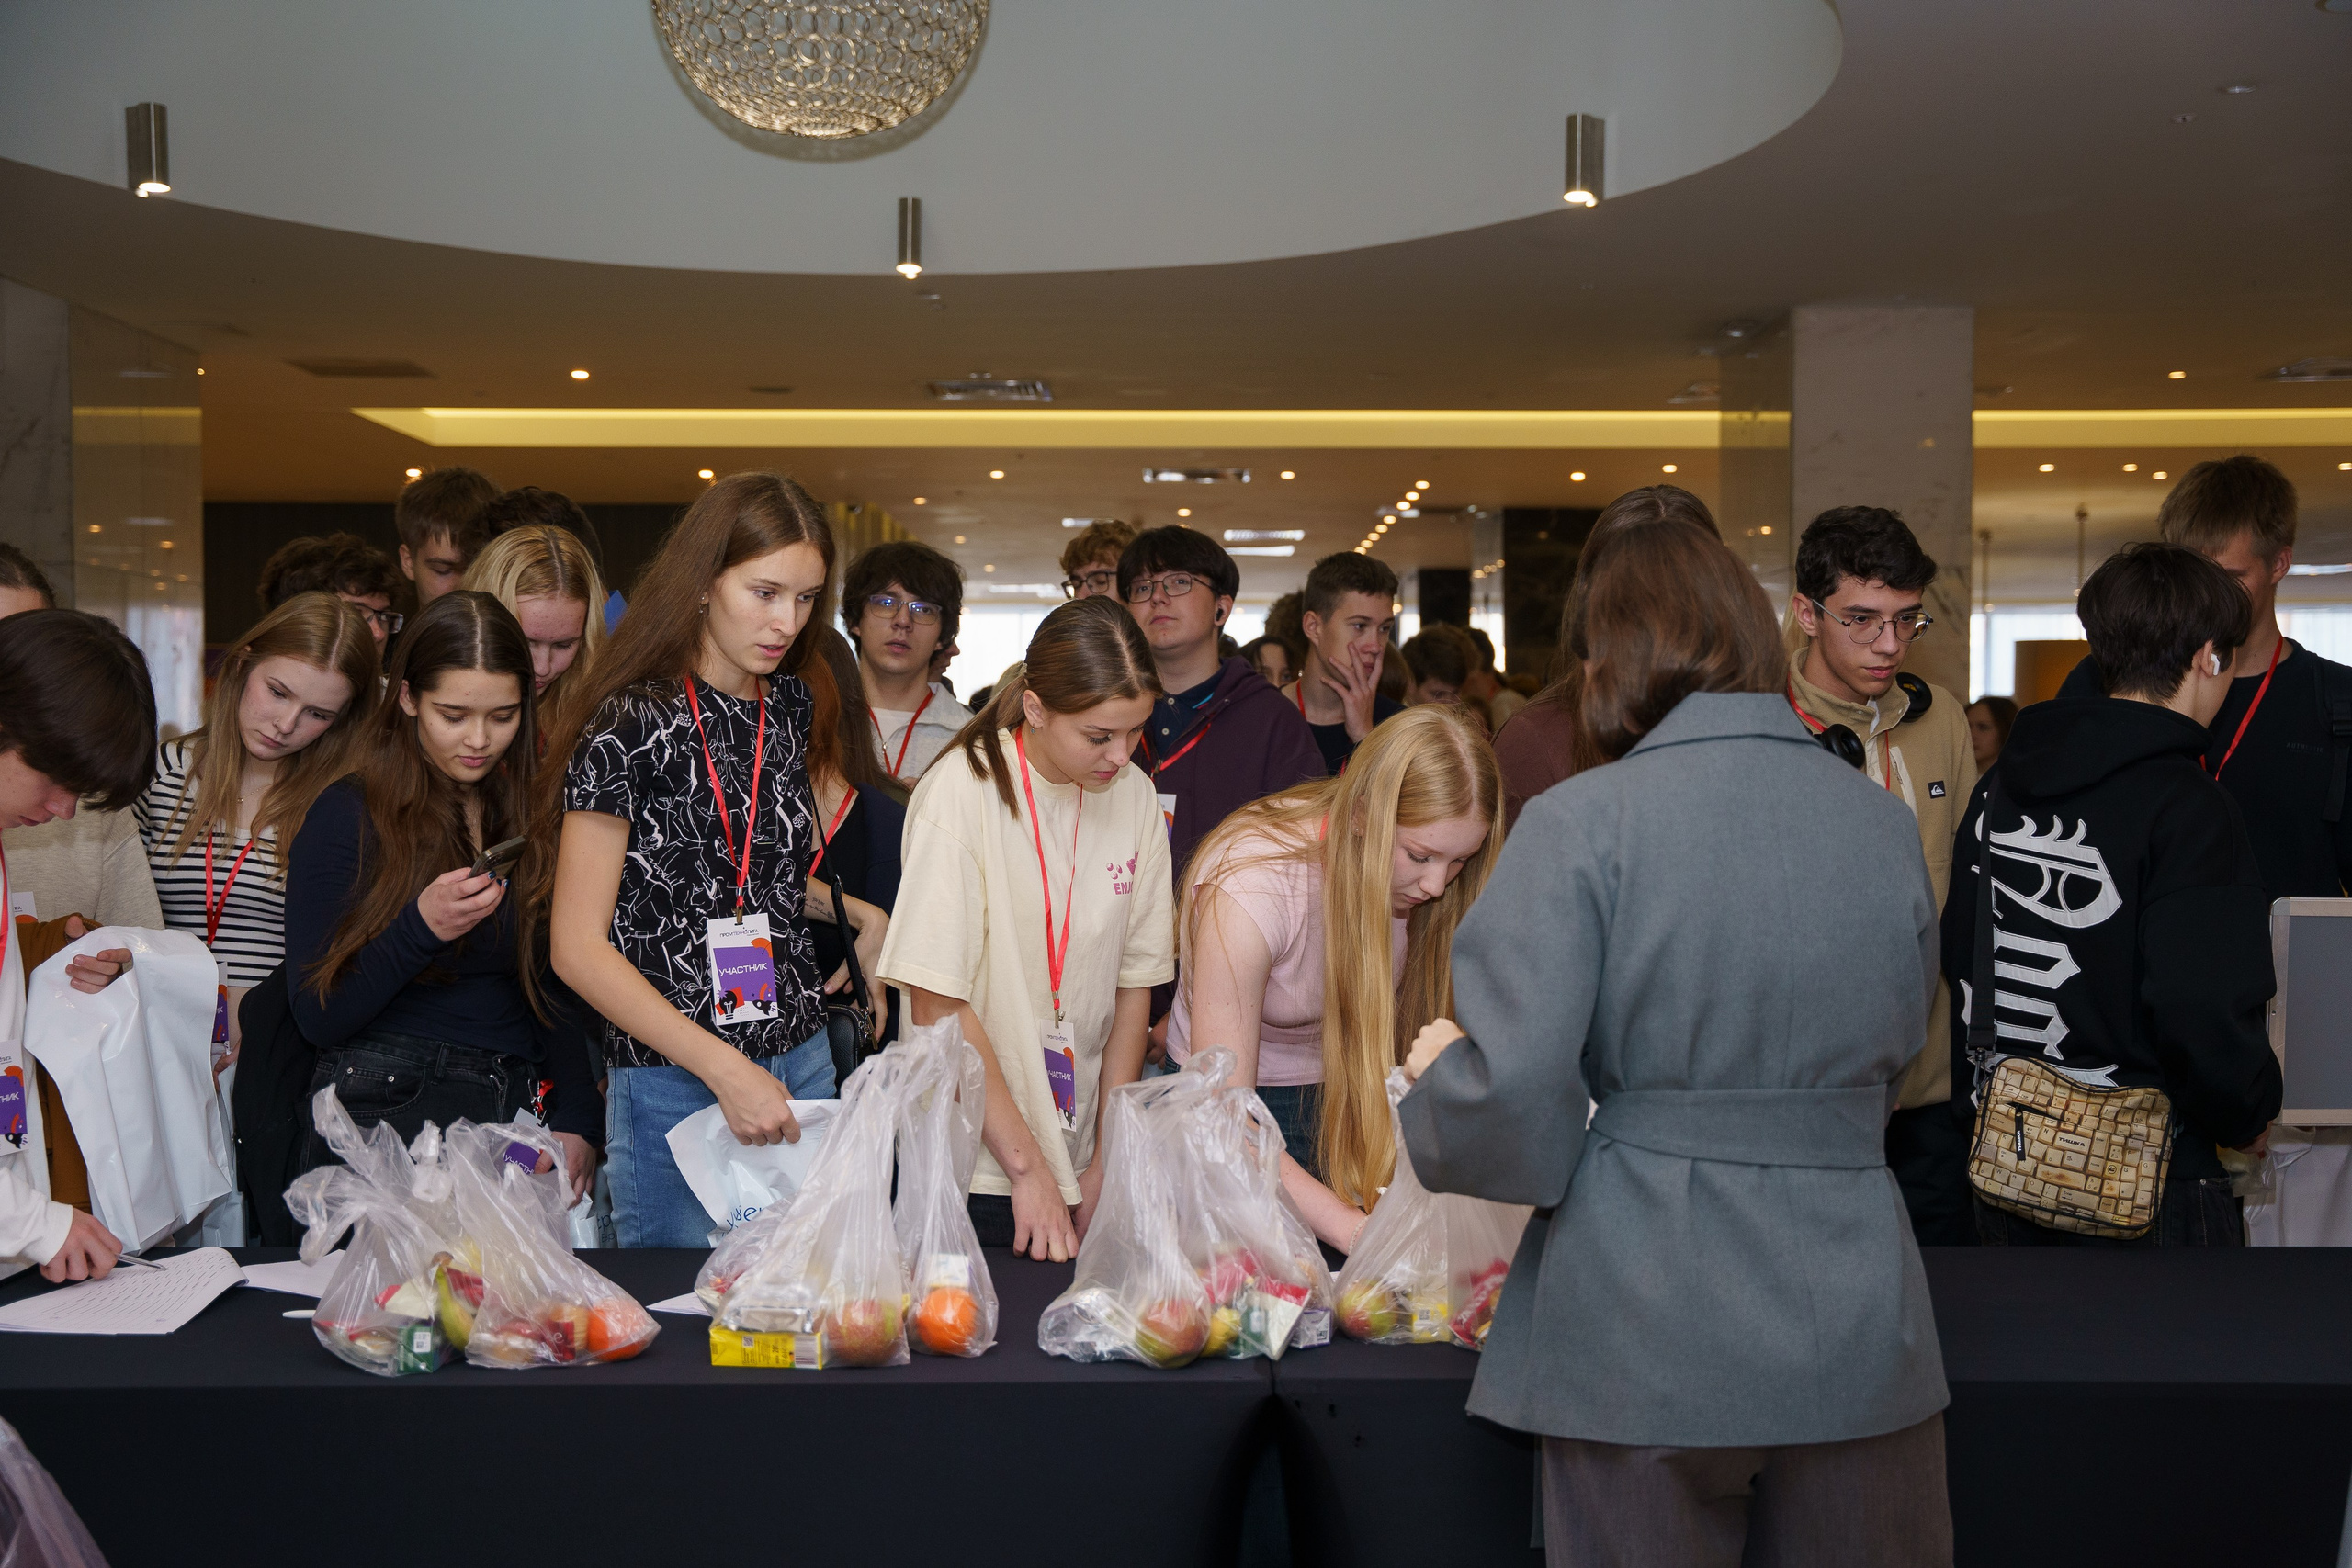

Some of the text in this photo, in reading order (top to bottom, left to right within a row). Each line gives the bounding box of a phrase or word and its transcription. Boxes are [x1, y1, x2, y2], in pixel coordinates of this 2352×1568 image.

[1113, 881, 1134, 895] ENJ
[718, 962, 768, 976] УЧАСТНИК
[2059, 1136, 2086, 1147] ТИШКА
